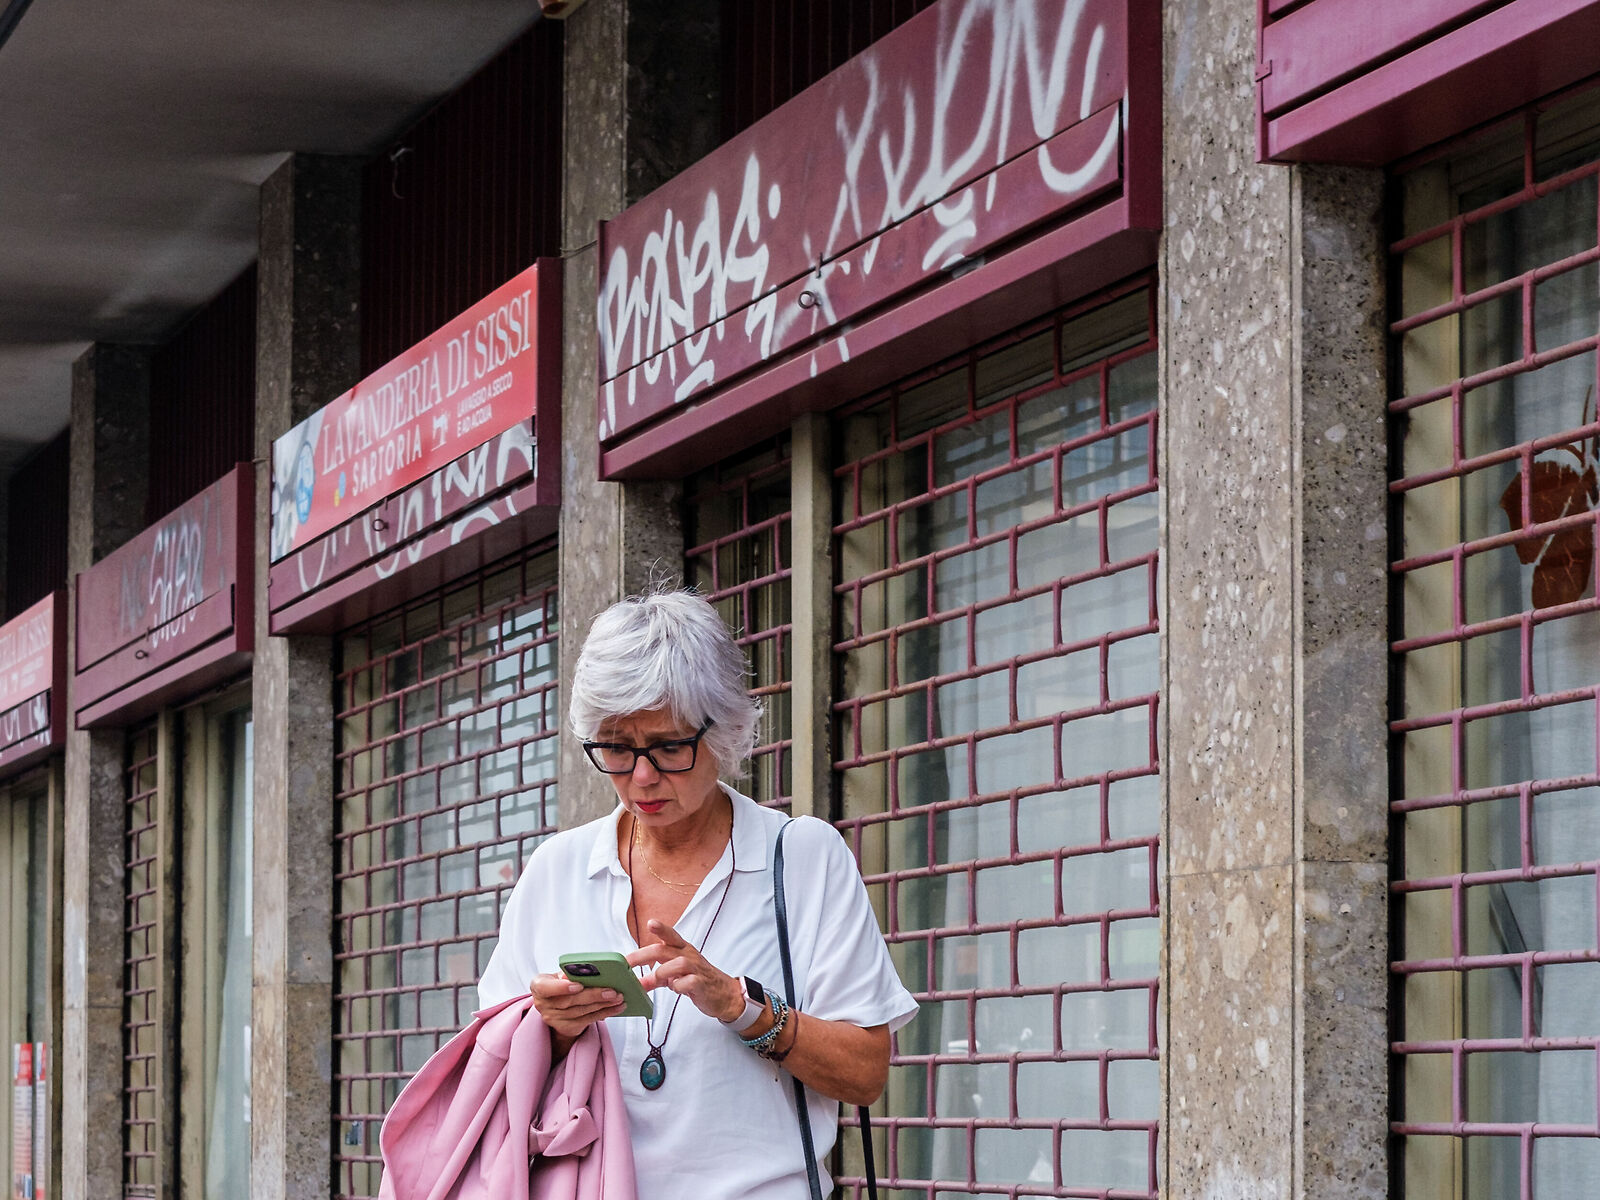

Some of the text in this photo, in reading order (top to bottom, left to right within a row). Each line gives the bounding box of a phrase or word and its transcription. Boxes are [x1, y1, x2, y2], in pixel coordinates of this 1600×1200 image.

[322, 289, 532, 476] LAVANDERIA DI SISSI
[352, 424, 422, 497] SARTORIA
